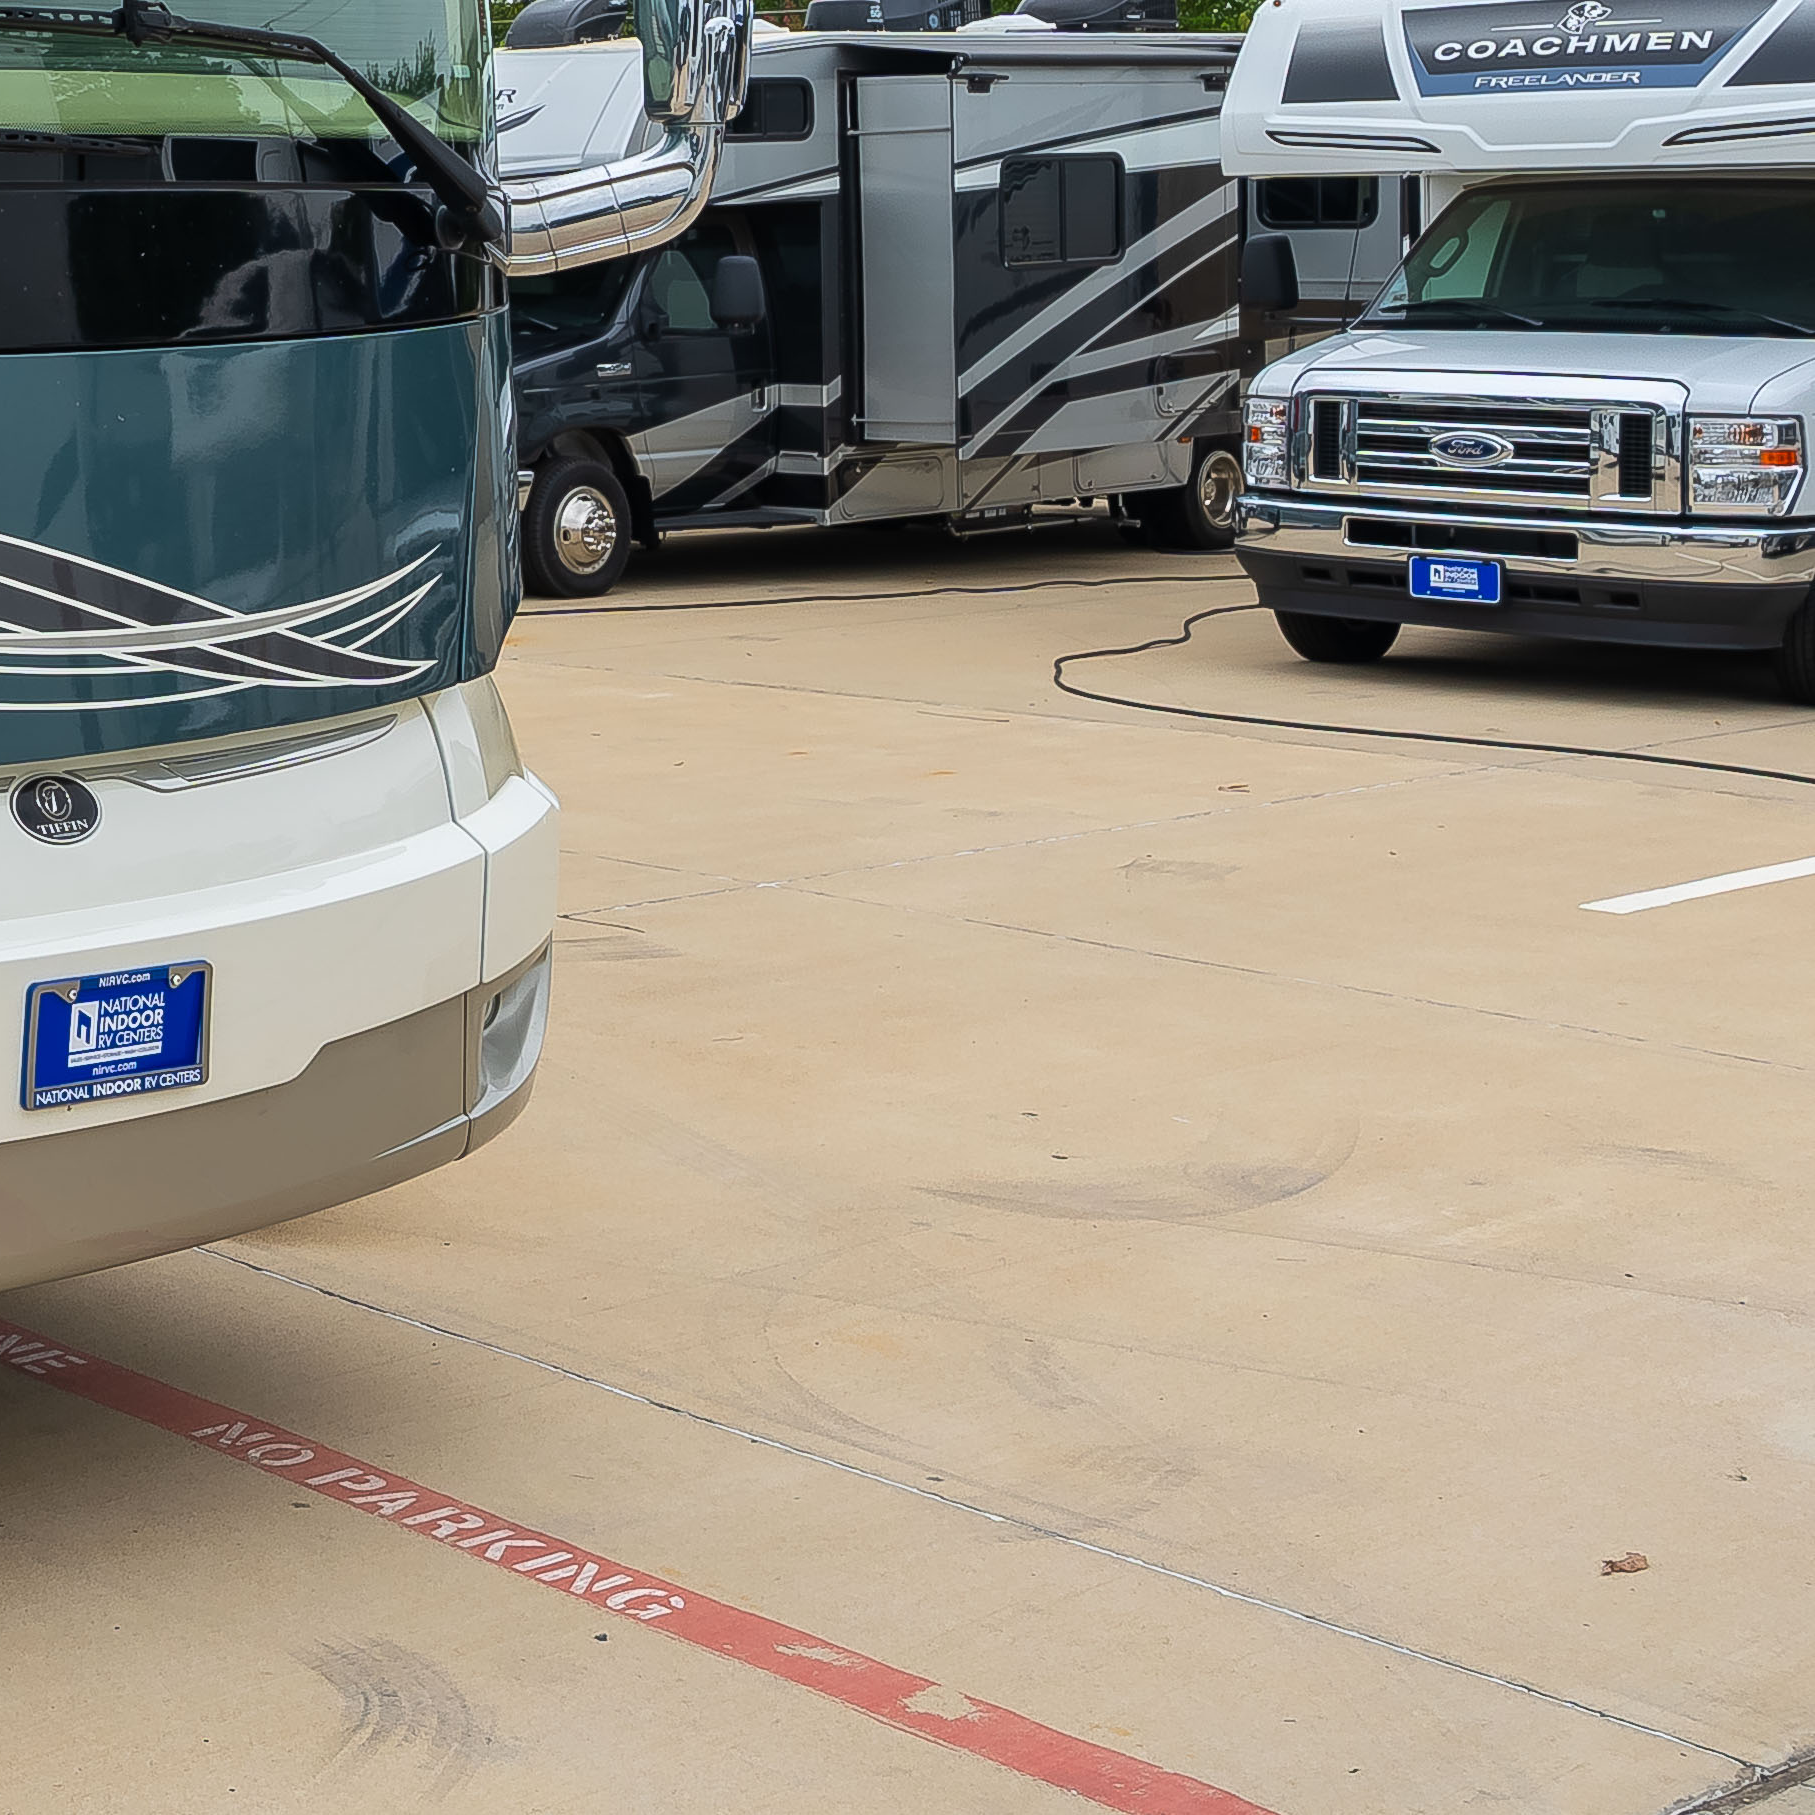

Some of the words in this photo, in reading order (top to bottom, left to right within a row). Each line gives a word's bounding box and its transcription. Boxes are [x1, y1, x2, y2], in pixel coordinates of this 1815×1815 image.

[1434, 30, 1713, 62] COACHMEN
[1474, 71, 1641, 89] FREELANDER
[1448, 439, 1484, 455] Ford
[37, 819, 89, 835] TIFFIN
[99, 972, 151, 988] NIRVC.com
[101, 992, 165, 1015] NATIONAL
[100, 1009, 164, 1032] INDOOR
[98, 1033, 113, 1048] RV
[116, 1026, 164, 1045] CENTERS
[92, 1061, 137, 1076] nirvc.com
[36, 1087, 89, 1106] NATIONAL
[92, 1079, 142, 1097] INDOOR
[144, 1075, 158, 1089] RV
[159, 1069, 201, 1086] CENTERS
[191, 1421, 316, 1468] NO
[305, 1467, 686, 1622] PARKING
